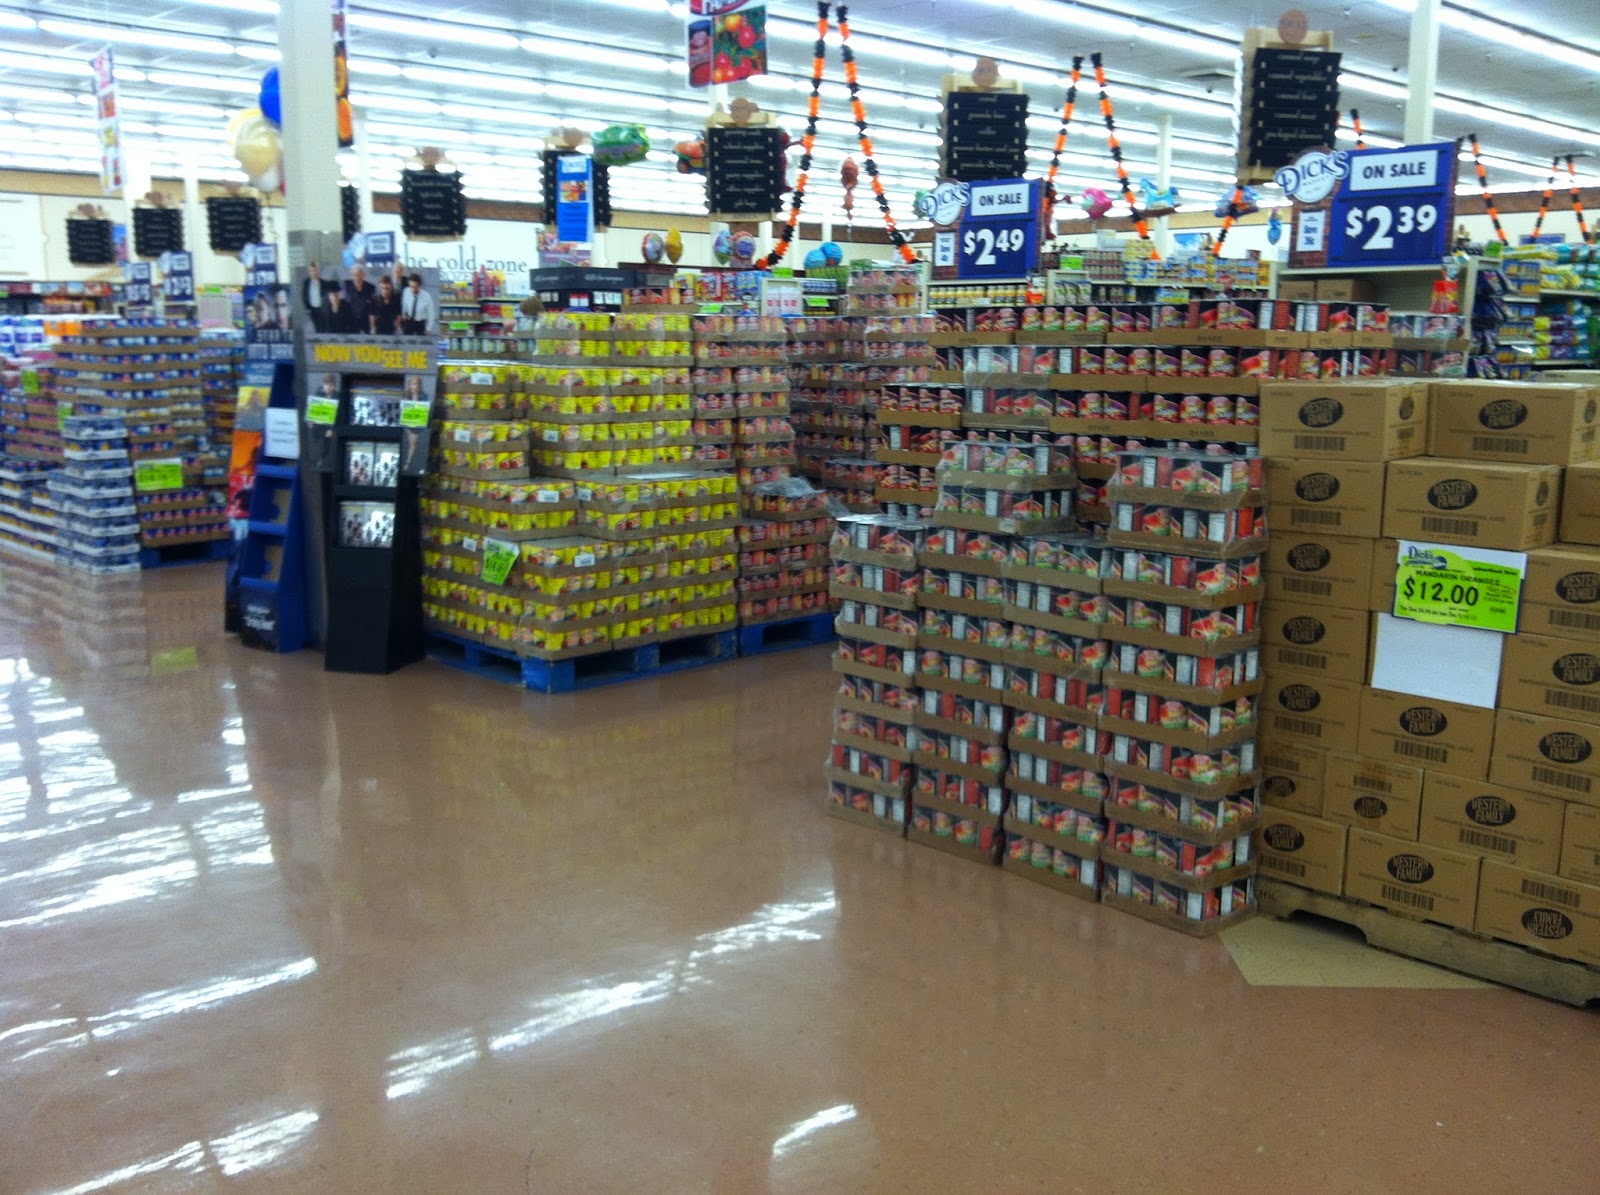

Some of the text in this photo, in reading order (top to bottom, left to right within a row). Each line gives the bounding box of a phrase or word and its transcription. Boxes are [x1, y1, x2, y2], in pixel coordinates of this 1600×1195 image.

[1363, 161, 1426, 180] ON SALE
[980, 192, 1022, 207] ON SALE
[436, 244, 478, 271] cold
[485, 259, 528, 273] zone
[1403, 574, 1479, 607] $12.00
